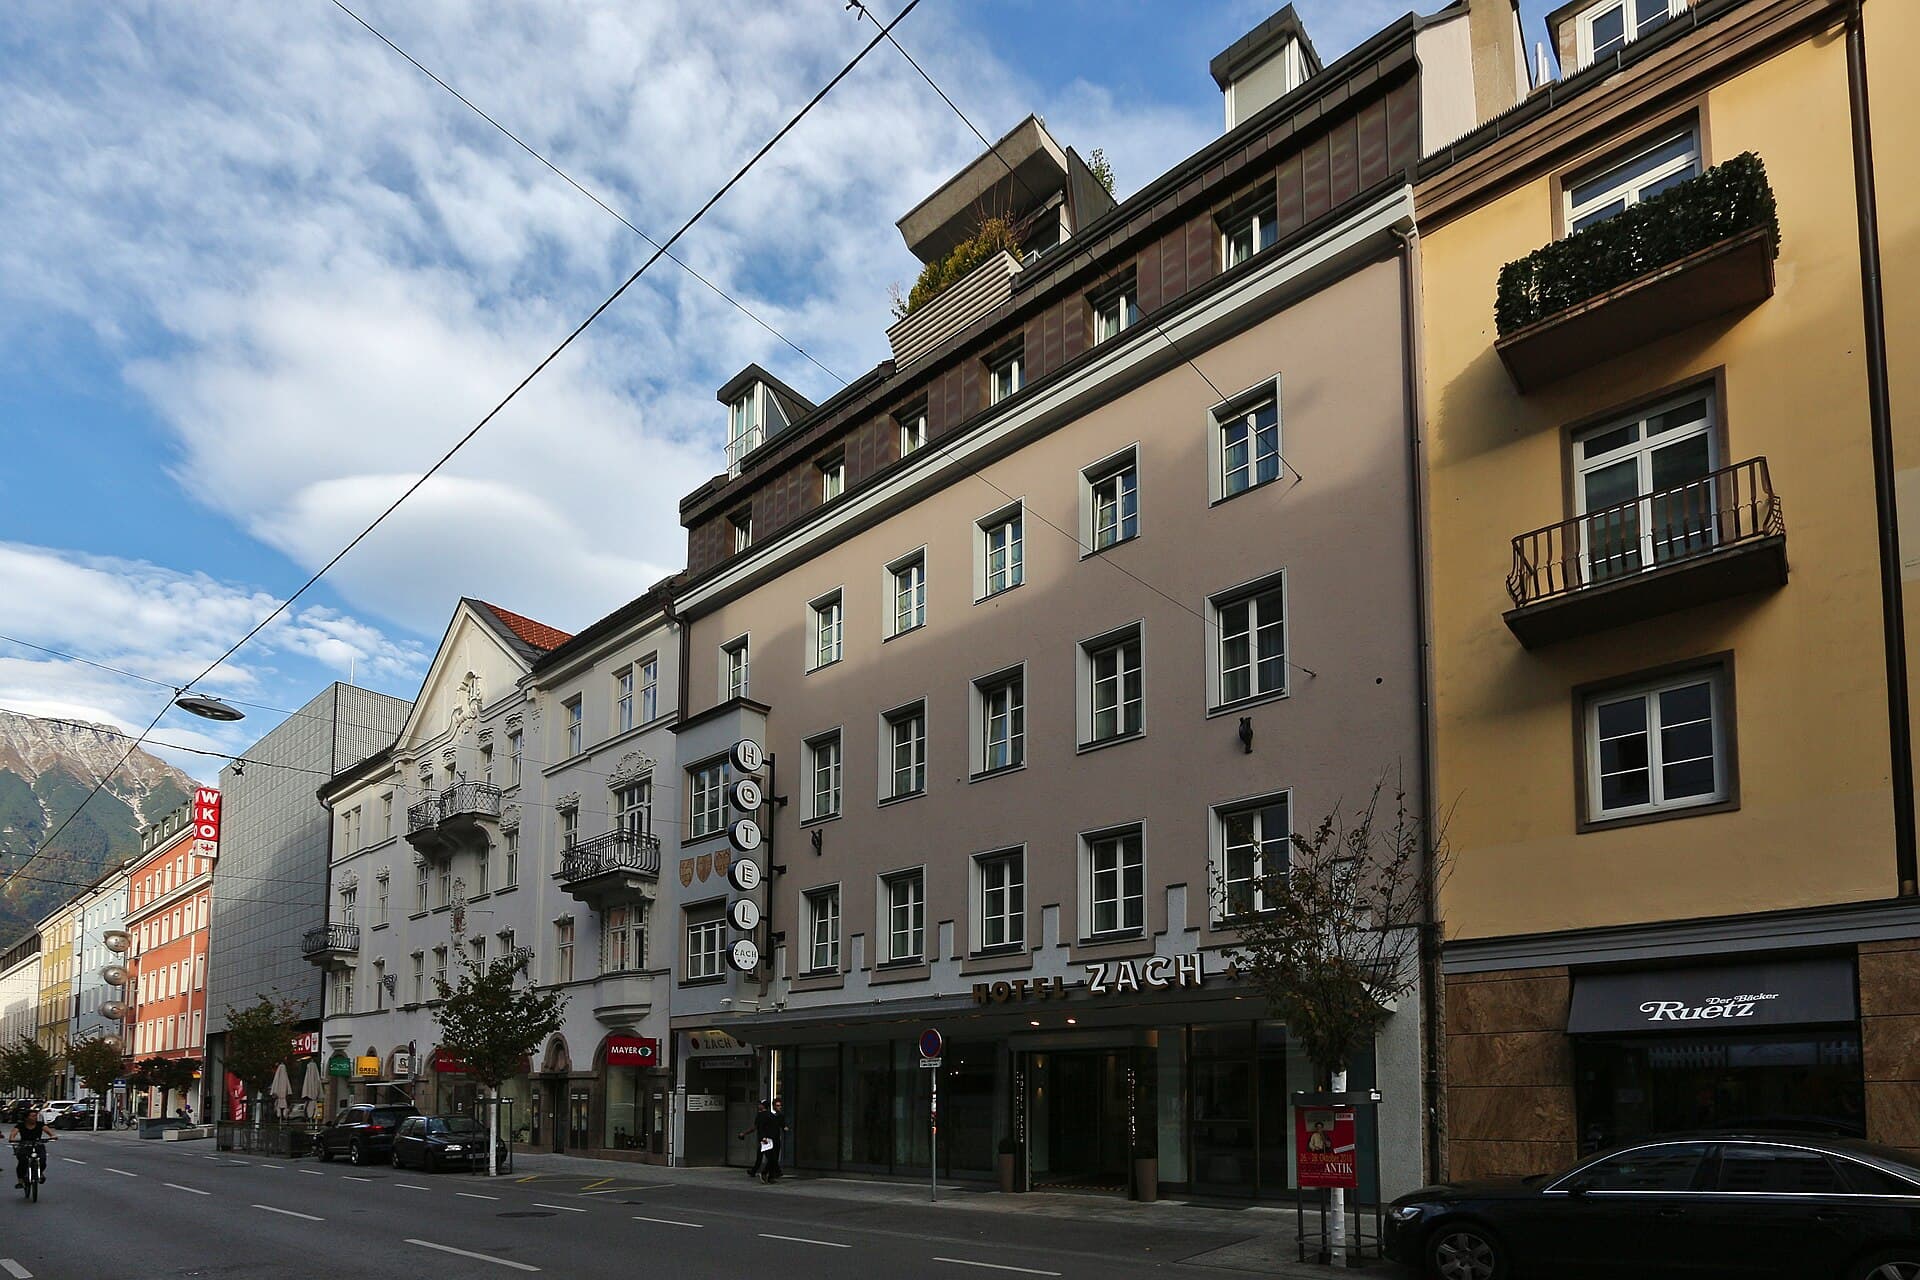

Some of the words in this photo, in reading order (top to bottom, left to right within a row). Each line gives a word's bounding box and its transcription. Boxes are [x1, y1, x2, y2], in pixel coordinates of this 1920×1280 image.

[200, 790, 219, 838] WKO
[742, 745, 757, 924] HOTEL
[734, 948, 757, 959] ZACH
[972, 976, 1067, 1003] HOTEL
[1086, 953, 1205, 993] ZACH
[1705, 997, 1733, 1005] Der
[1734, 992, 1779, 1003] Bäcker
[1639, 1000, 1756, 1021] Ruetz
[611, 1045, 638, 1054] MAYER
[704, 1039, 732, 1049] ZACH
[1324, 1163, 1353, 1174] ANTIK
